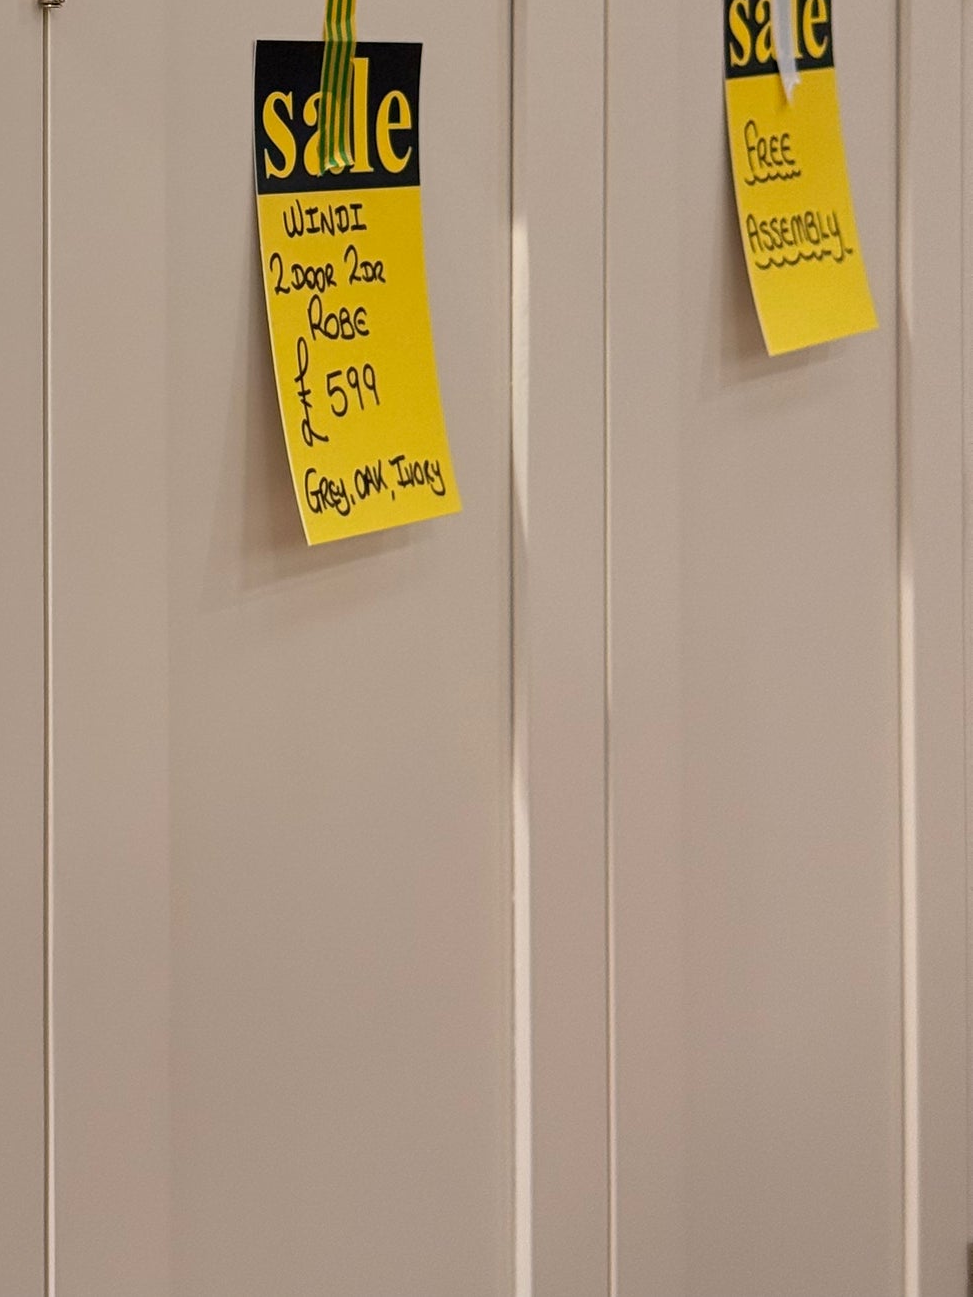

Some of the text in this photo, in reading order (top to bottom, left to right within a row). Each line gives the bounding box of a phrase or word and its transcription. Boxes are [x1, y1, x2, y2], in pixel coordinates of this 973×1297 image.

[262, 56, 413, 179] sale
[744, 119, 796, 172] FREE
[283, 199, 367, 238] WINDI
[307, 294, 369, 341] ROBE
